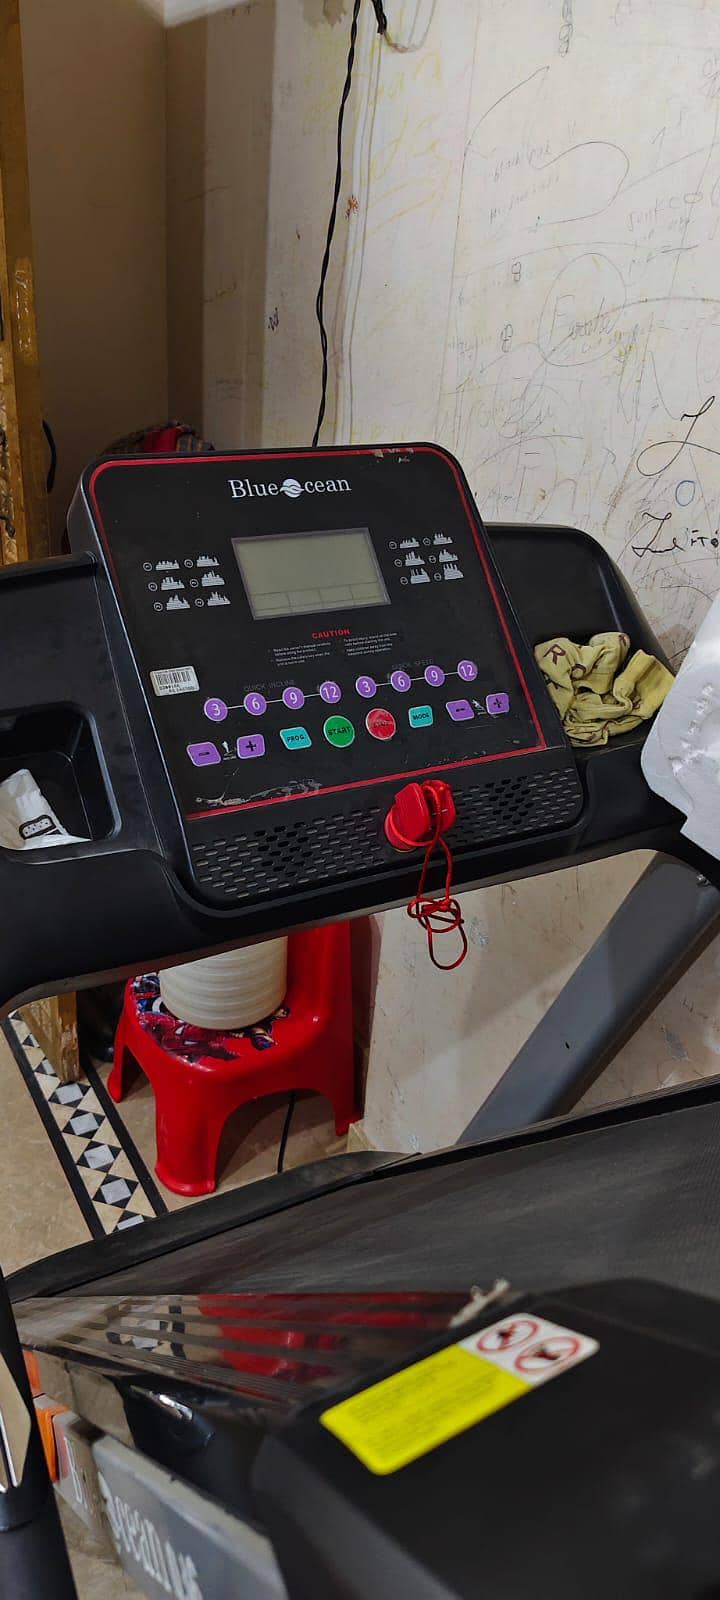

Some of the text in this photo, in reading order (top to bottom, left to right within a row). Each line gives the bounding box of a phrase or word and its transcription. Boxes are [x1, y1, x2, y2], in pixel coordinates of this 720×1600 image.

[228, 479, 279, 499] Blue
[312, 628, 352, 640] CAUTION
[363, 665, 475, 692] 3 6 9 12
[212, 686, 339, 716] 3 6 9 12
[328, 726, 352, 735] START
[412, 713, 430, 721] MODE
